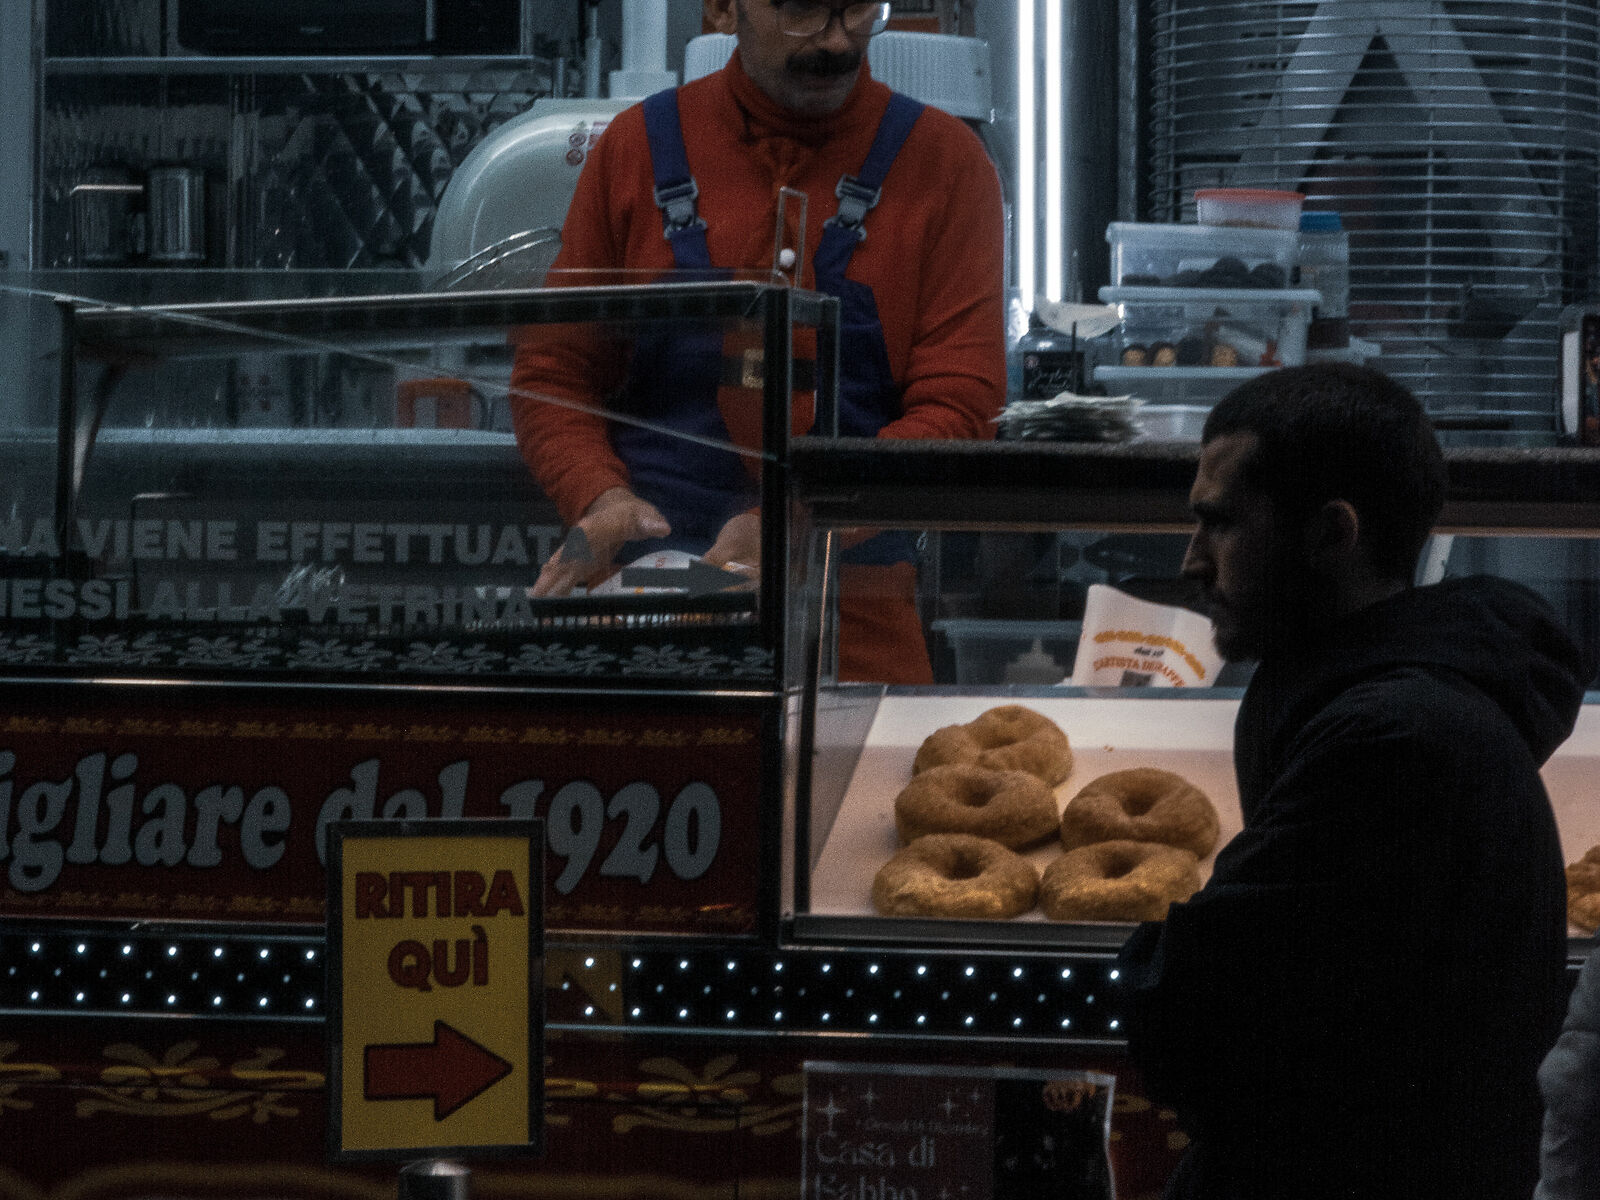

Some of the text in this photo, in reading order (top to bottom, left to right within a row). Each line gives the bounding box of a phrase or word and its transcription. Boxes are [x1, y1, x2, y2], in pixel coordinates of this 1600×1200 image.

[76, 519, 239, 560] VIENE
[256, 521, 593, 566] EFFETTUATA
[0, 578, 535, 628] ESSI ALLA VETRINA
[355, 870, 525, 920] RITIRA
[386, 924, 490, 992] QUÌ
[814, 1131, 936, 1168] Casa di
